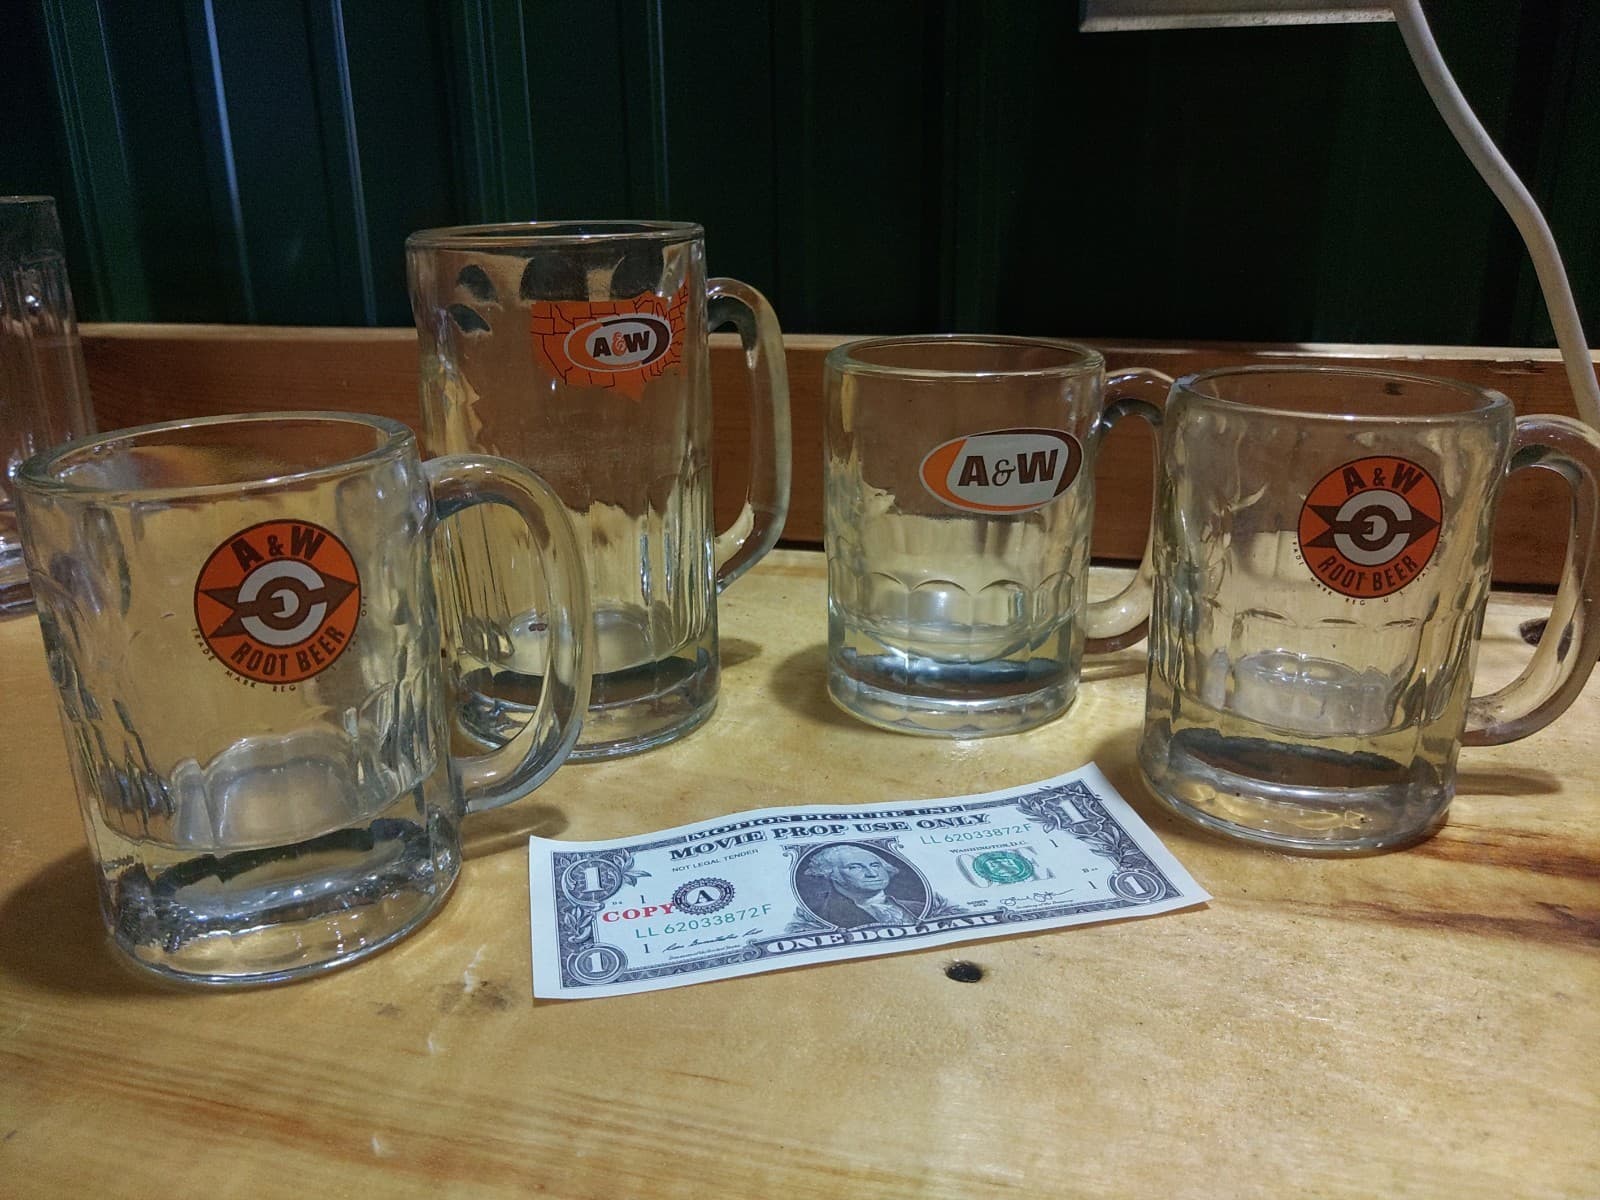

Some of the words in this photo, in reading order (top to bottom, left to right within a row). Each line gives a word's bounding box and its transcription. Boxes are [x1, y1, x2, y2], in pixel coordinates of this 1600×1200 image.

[592, 330, 650, 358] A&W
[957, 448, 1059, 487] A&W
[1317, 555, 1366, 591] ROOT
[1372, 555, 1417, 592] BEER
[230, 642, 289, 676] ROOT
[295, 625, 345, 672] BEER
[669, 830, 768, 861] MOVIE
[771, 824, 848, 840] PROP
[852, 821, 912, 834] USE
[915, 813, 991, 830] ONLY
[688, 815, 793, 843] MOTION
[800, 810, 904, 822] PICTURE
[912, 805, 964, 816] USE
[672, 863, 691, 873] NOT
[693, 858, 721, 870] LEGAL
[724, 849, 760, 862] TENDER
[602, 902, 677, 923] COPY
[694, 889, 715, 904] A
[766, 932, 845, 954] ONE
[850, 914, 998, 943] DOLLAR
